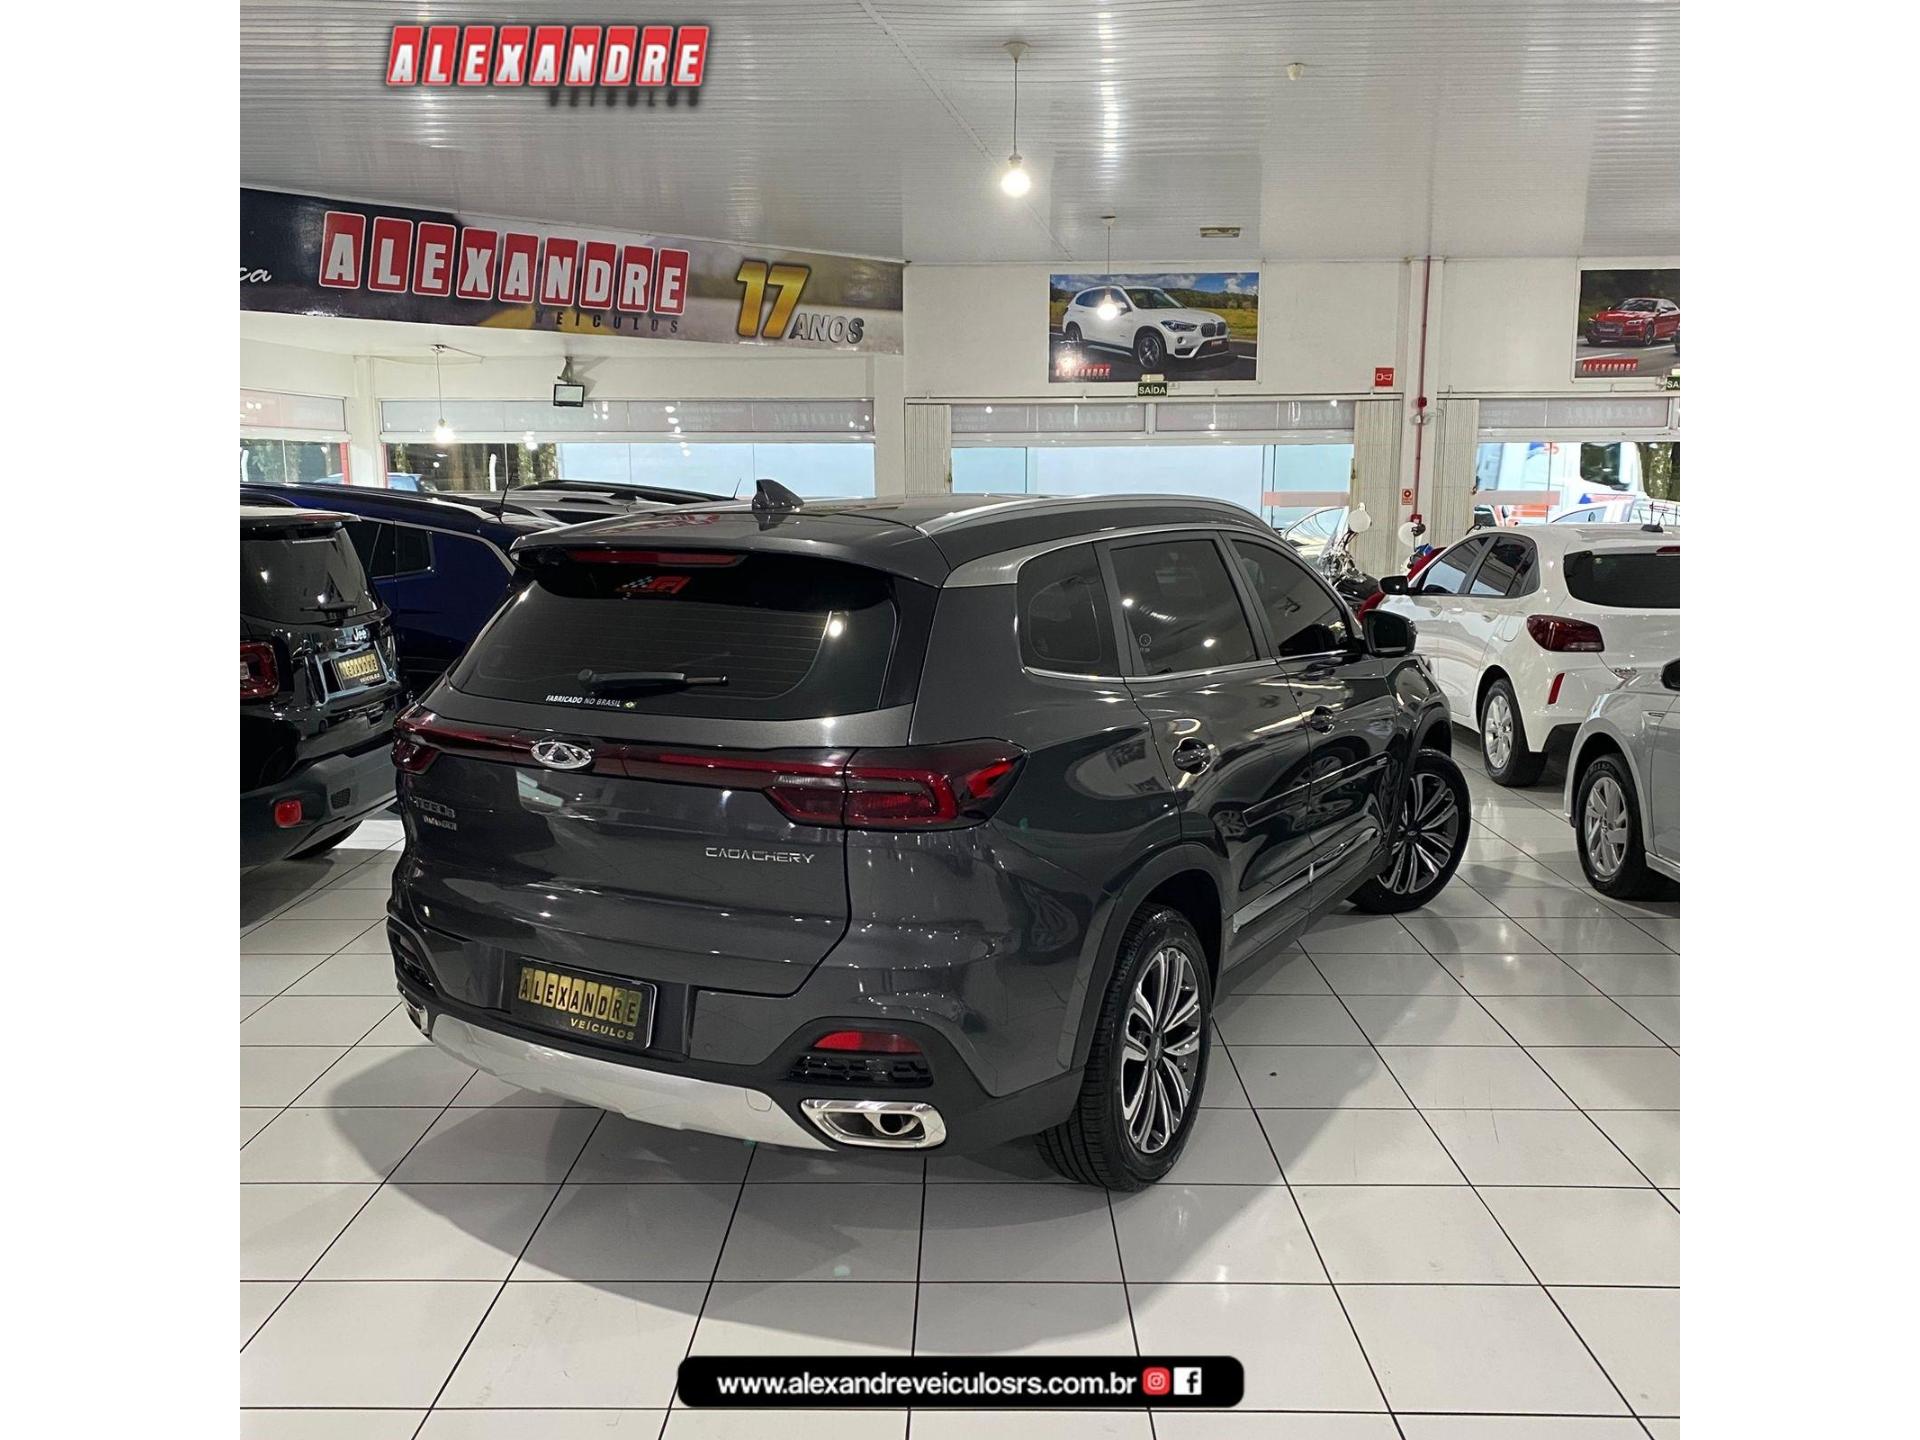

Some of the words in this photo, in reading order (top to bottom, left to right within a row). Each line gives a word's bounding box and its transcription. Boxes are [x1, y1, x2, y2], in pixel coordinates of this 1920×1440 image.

[324, 229, 683, 310] ALEXANDRE
[736, 260, 812, 339] 17
[790, 313, 865, 344] ANOS
[545, 694, 583, 704] FABRICADO
[584, 697, 595, 705] NO
[596, 698, 620, 707] BRASIL
[520, 973, 639, 1025] ALEXANDRE
